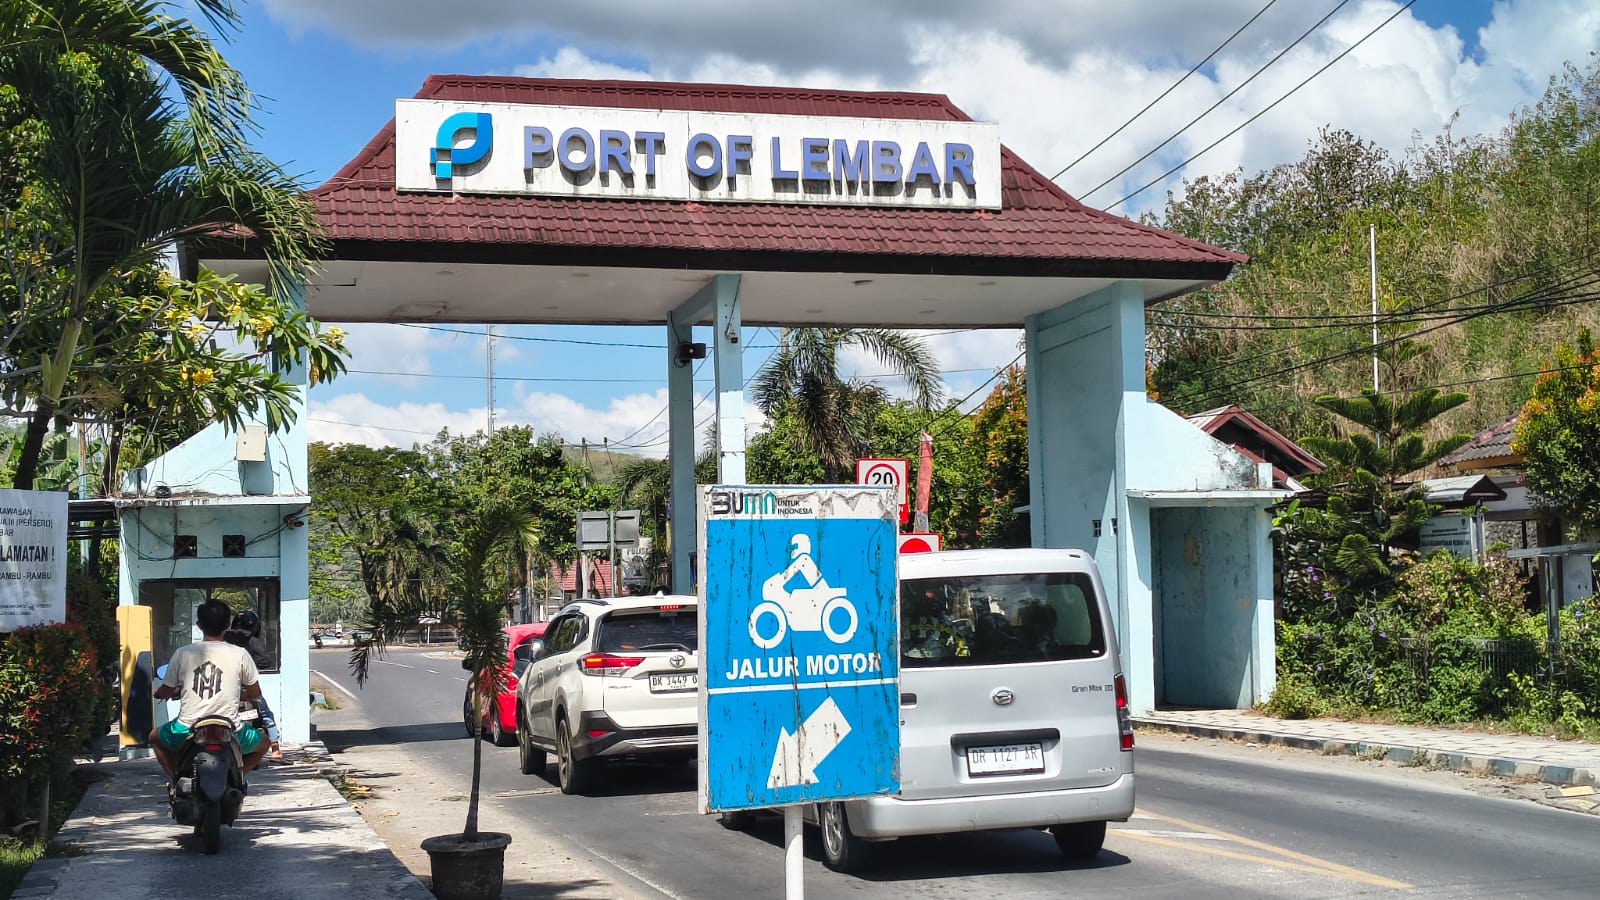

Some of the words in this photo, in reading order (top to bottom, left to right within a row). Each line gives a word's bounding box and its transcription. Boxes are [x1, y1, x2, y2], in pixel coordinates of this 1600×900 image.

[523, 125, 666, 176] PORT
[686, 132, 753, 178] OF
[770, 135, 977, 186] LEMBAR
[872, 471, 893, 485] 20
[777, 499, 800, 507] UNTUK
[725, 656, 800, 681] JALUR
[805, 652, 881, 676] MOTOR
[972, 749, 986, 763] DR
[992, 747, 1018, 763] 1127
[1024, 745, 1039, 760] AR
